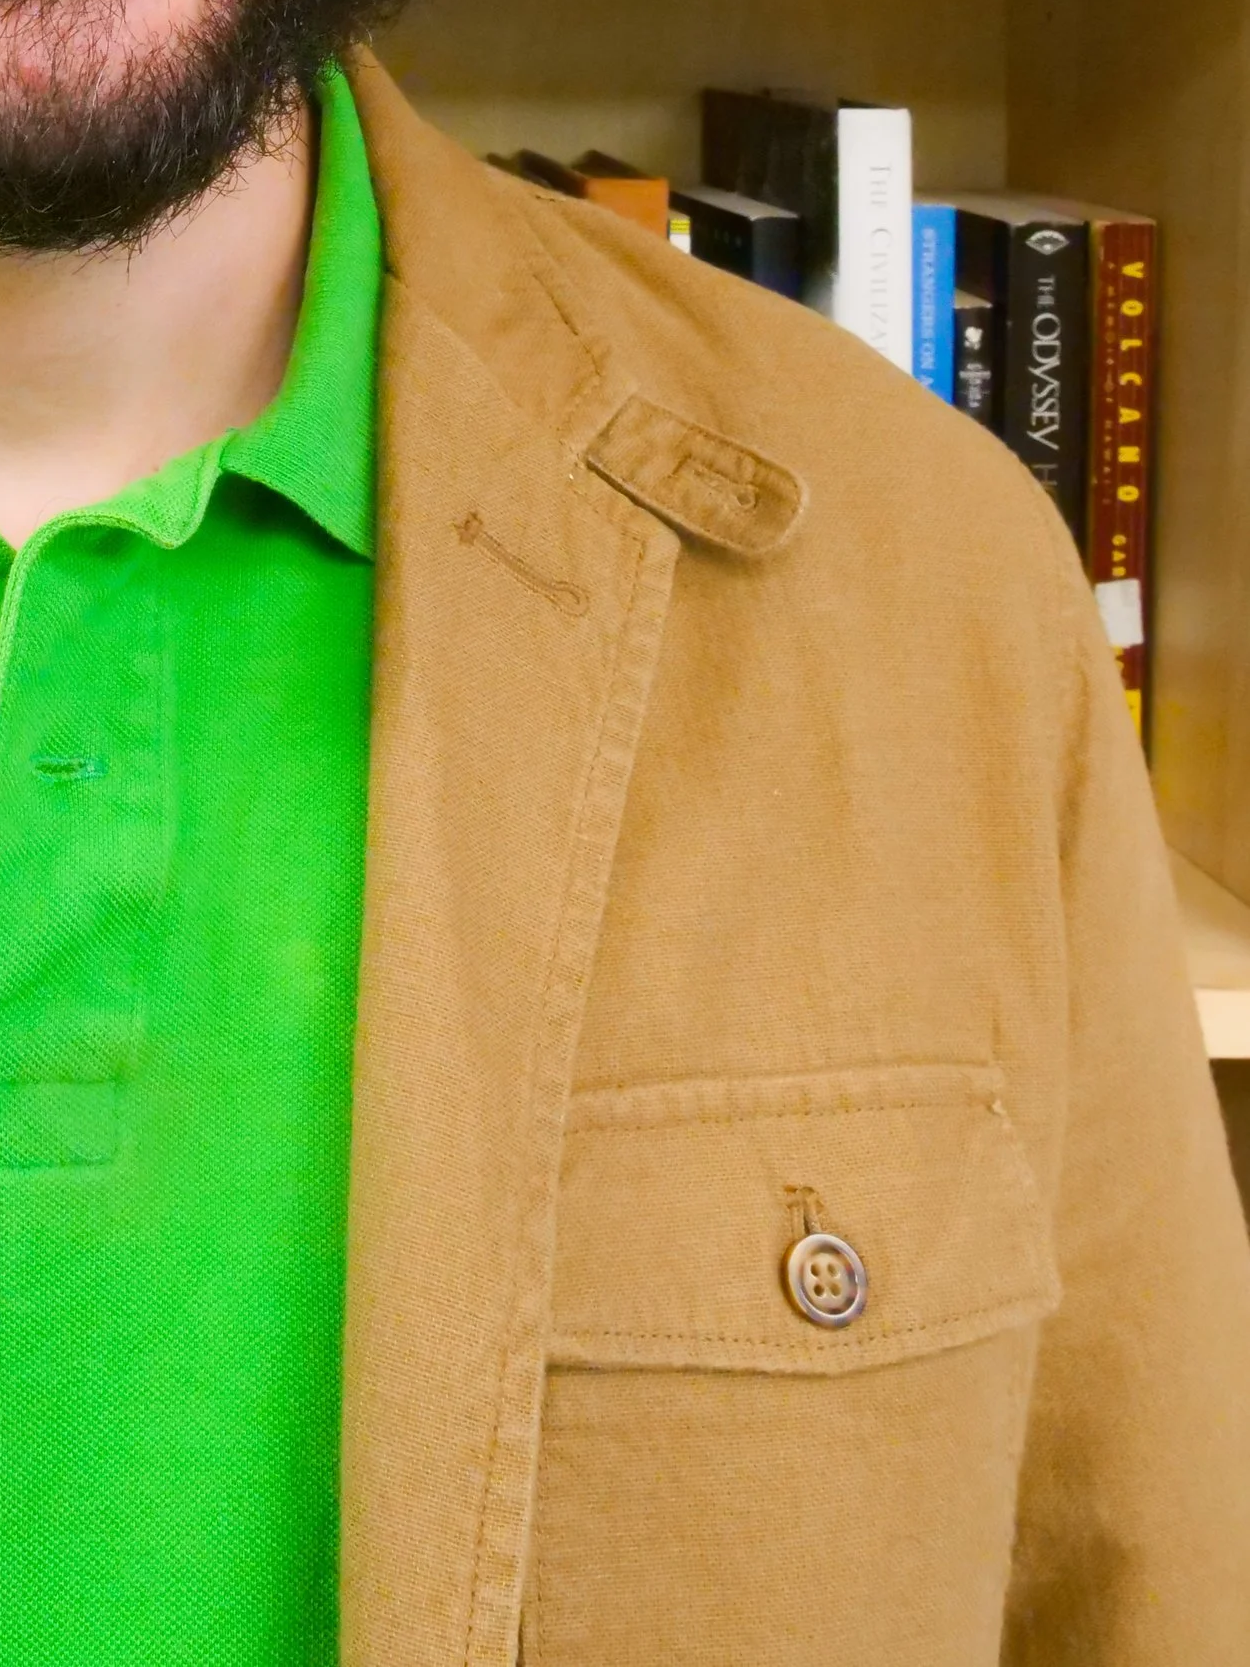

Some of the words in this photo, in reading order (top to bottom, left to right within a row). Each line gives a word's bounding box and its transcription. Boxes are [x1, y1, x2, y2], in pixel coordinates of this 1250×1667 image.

[868, 163, 892, 207] THE
[1036, 275, 1055, 311] THE
[1026, 313, 1062, 450] ODYSSEY
[1116, 260, 1145, 503] VOLCANO
